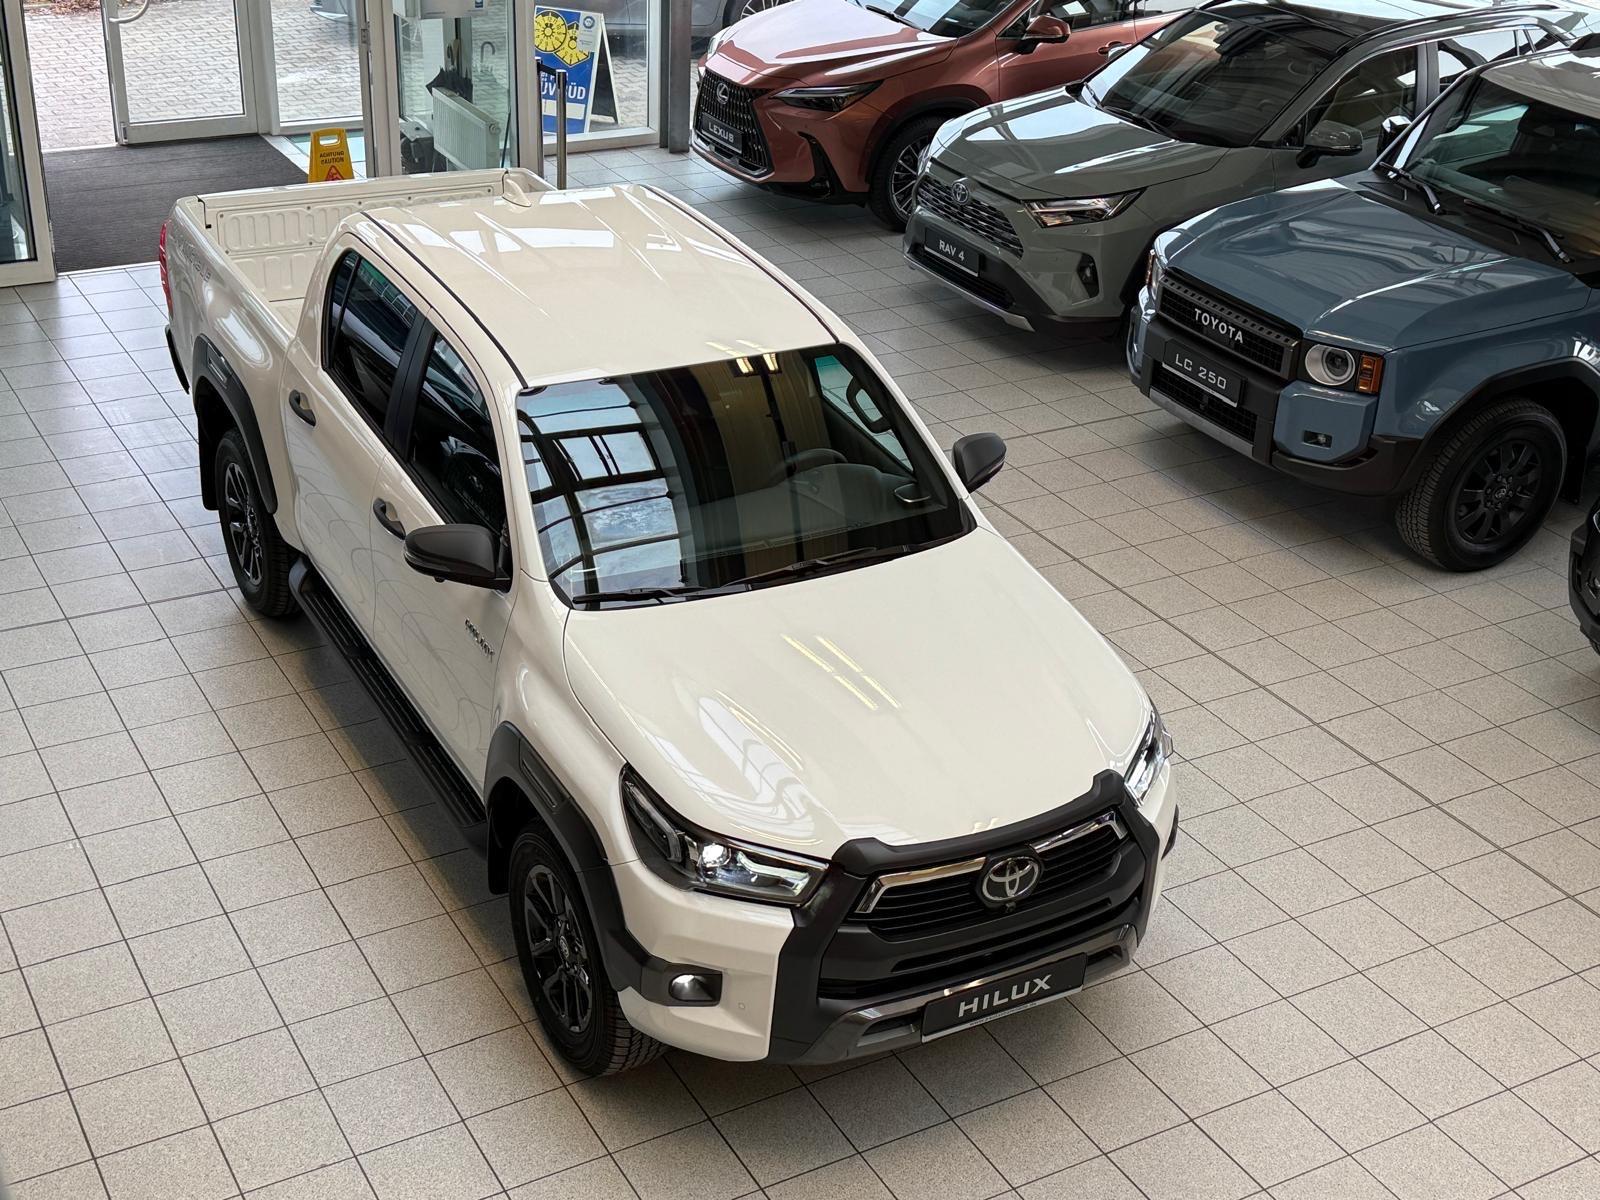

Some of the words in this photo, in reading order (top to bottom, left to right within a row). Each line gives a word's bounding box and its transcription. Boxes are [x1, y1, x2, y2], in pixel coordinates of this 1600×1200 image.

[541, 78, 557, 96] ÜV
[566, 82, 586, 99] ÜD
[708, 122, 734, 143] LEXUS
[321, 157, 344, 165] CAUTION
[939, 240, 957, 256] RAV
[958, 251, 965, 262] 4
[1194, 308, 1244, 344] TOYOTA
[1175, 353, 1192, 371] LC
[1197, 366, 1227, 390] 250
[957, 974, 1053, 1018] HILUX
